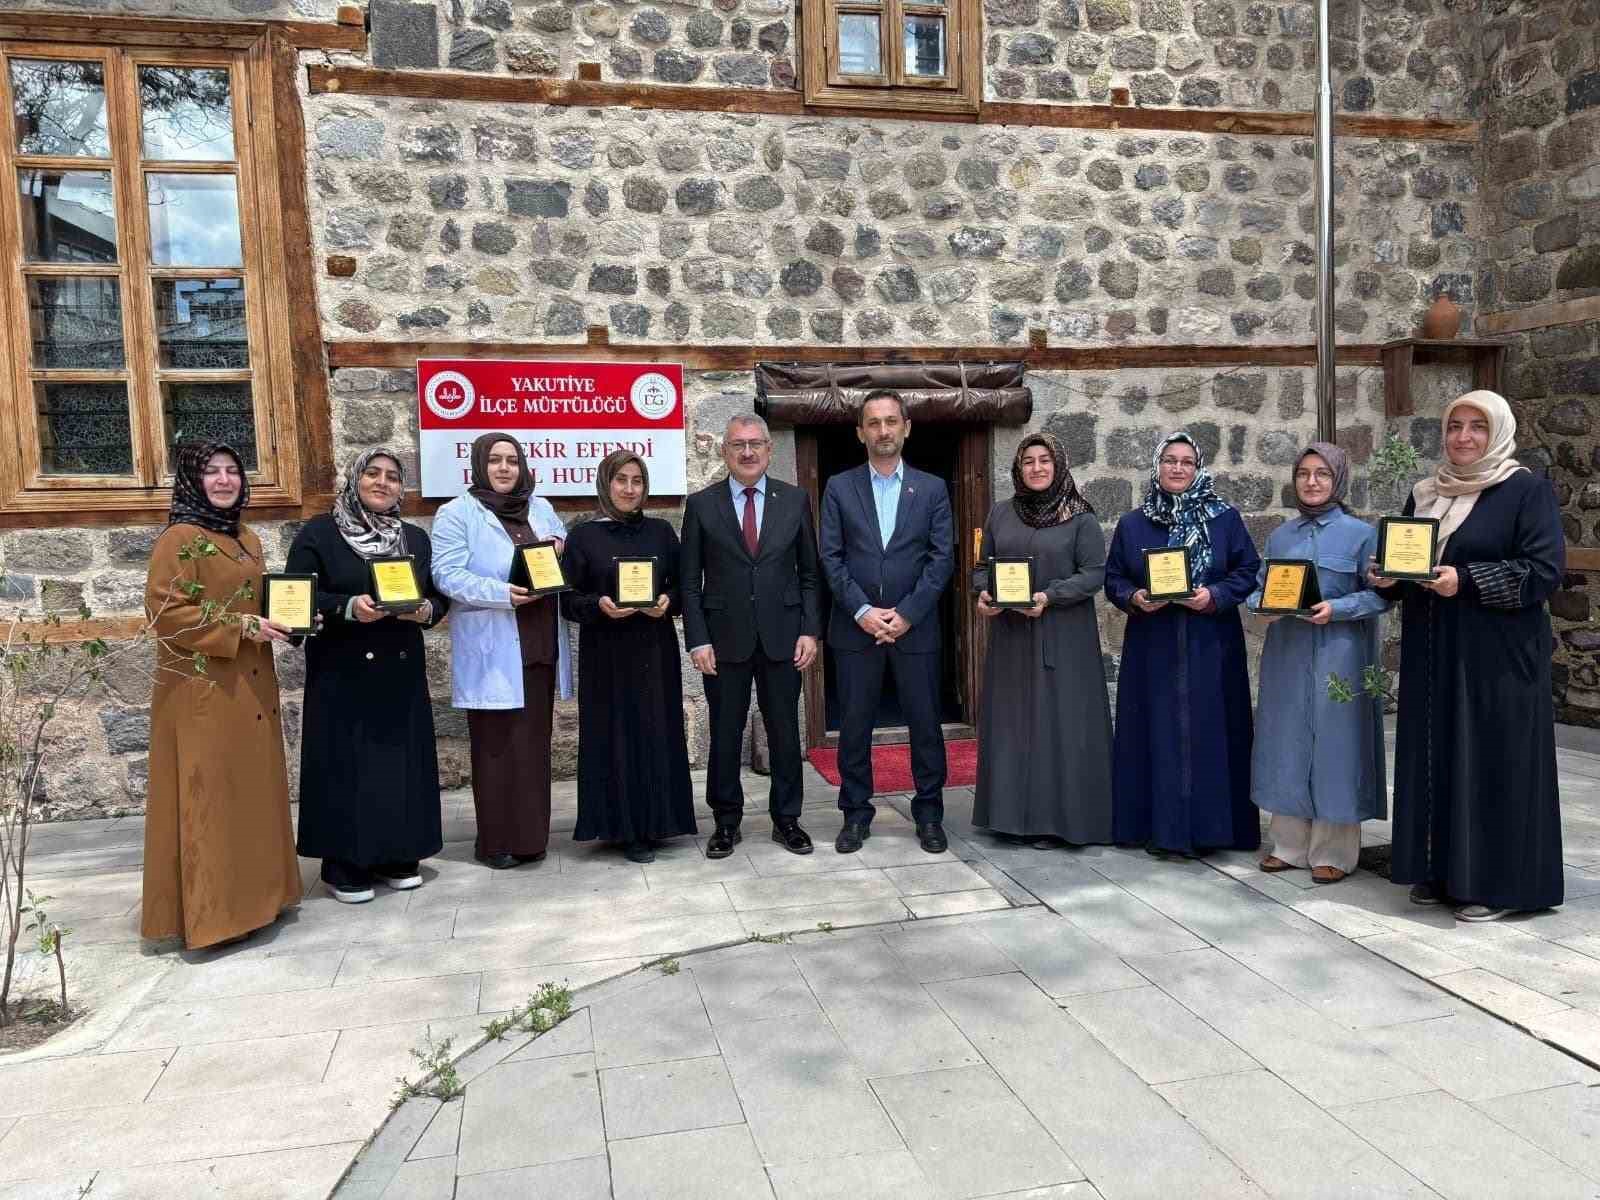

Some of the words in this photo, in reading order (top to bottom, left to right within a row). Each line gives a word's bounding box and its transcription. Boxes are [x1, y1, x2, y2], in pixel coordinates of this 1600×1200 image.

[511, 375, 595, 393] YAKUTİYE
[479, 395, 518, 416] İLÇE
[523, 396, 628, 414] MÜFTÜLÜĞÜ
